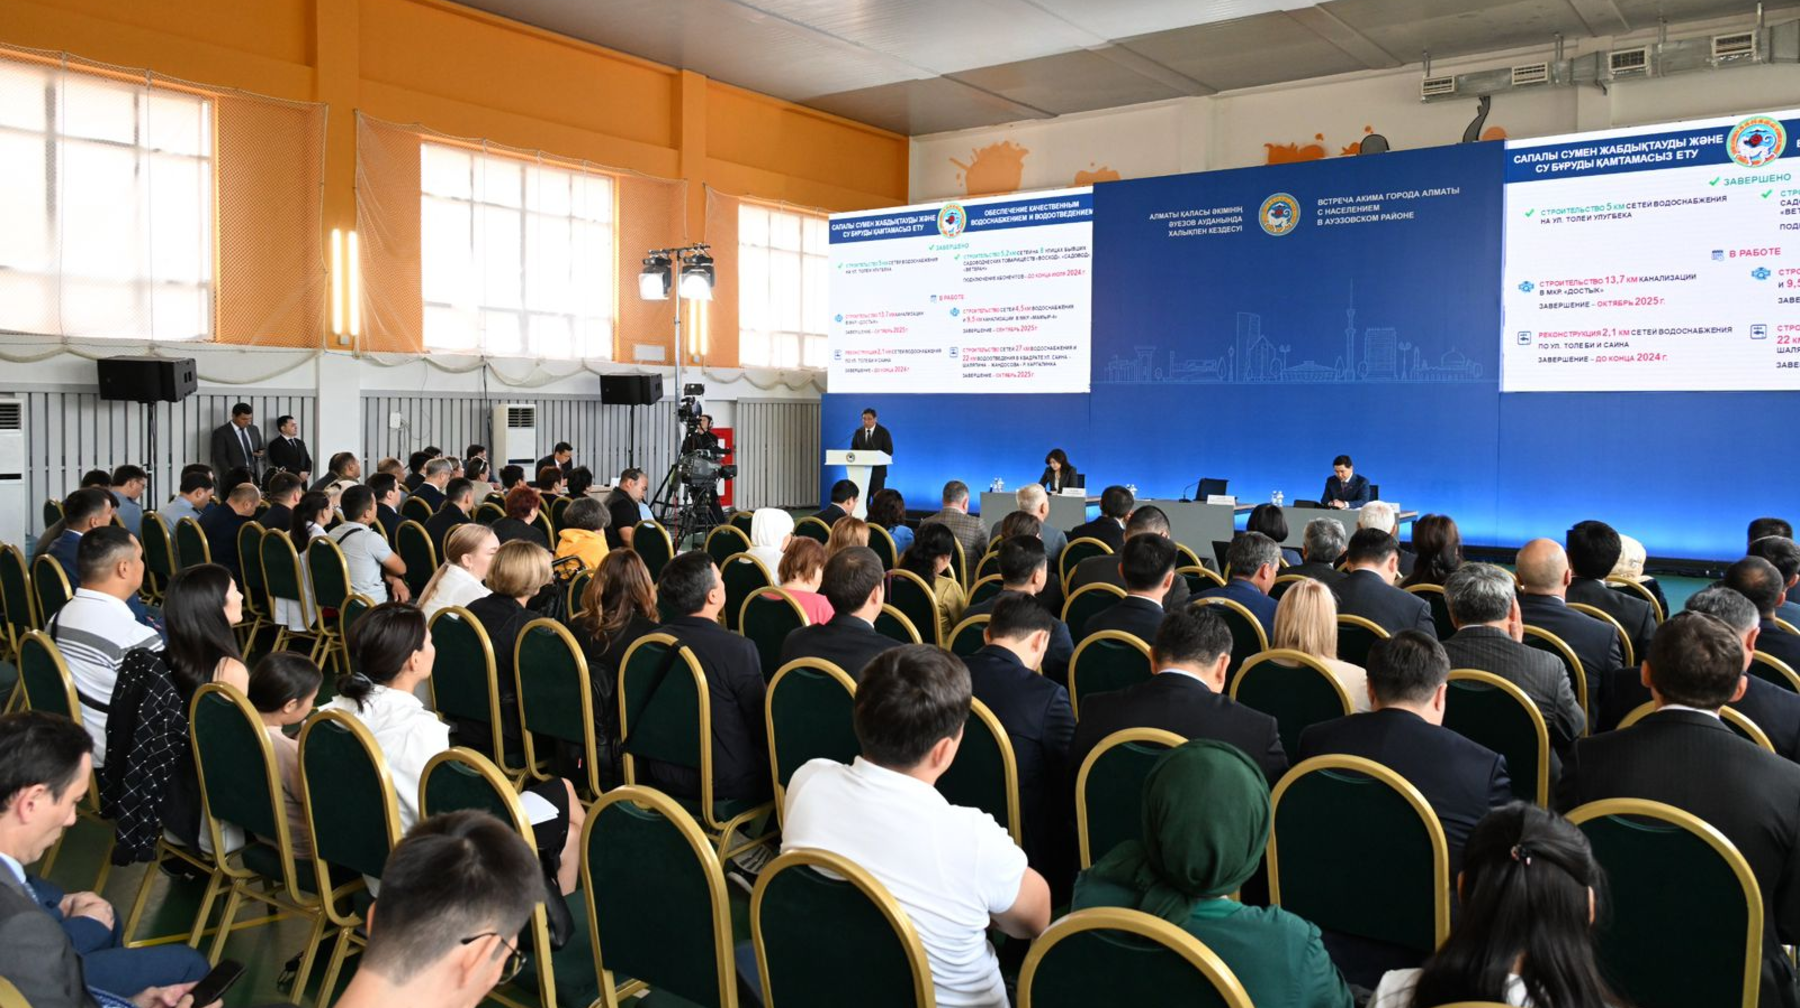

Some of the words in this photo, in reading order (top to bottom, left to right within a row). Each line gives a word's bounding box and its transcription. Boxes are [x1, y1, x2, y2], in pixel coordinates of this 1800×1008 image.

[1513, 152, 1558, 164] САПАЛЫ
[1561, 148, 1598, 159] СУМЕН
[1599, 138, 1687, 155] ЖАБДЫҚТАУДЫ
[1689, 134, 1724, 146] ЖӘНЕ
[1535, 164, 1549, 173] СУ
[1596, 151, 1673, 169] ҚАМТАМАСЫЗ
[1676, 149, 1699, 159] ЕТУ
[1724, 173, 1792, 186] ЗАВЕРШЕНО
[1317, 198, 1354, 206] ВСТРЕЧА
[1355, 194, 1384, 203] АКИМА
[1386, 191, 1420, 200] ГОРОДА
[1422, 187, 1459, 196] АЛМАТЫ
[984, 206, 1028, 216] ОБЕСПЕЧЕНИЕ
[1029, 201, 1079, 212] КАЧЕСТВЕННЫМ
[1325, 205, 1380, 215] НАСЕЛЕНИЕМ
[1541, 205, 1605, 216] СТРОИТЕЛЬСТВО
[1606, 203, 1612, 211] 5
[1653, 195, 1727, 207] ВОДОСНАБЖЕНИЯ
[970, 215, 1027, 226] ВОДОСНАБЖЕНИЕМ
[1149, 212, 1179, 220] АЛМАТЫ
[1180, 209, 1210, 218] ҚАЛАСЫ
[1324, 215, 1379, 225] АУЭЗОВСКОМ
[1381, 211, 1415, 221] РАЙОНЕ
[1169, 220, 1196, 228] ӘУЕЗОВ
[1197, 216, 1242, 226] АУДАНЫНДА
[1168, 229, 1207, 237] ХАЛЫҚПЕН
[1208, 226, 1242, 234] КЕЗДЕСУІ
[1729, 250, 1736, 258] В
[1739, 248, 1781, 257] РАБОТЕ
[1539, 278, 1604, 288] СТРОИТЕЛЬСТВО
[1605, 275, 1626, 285] 13,7
[1639, 273, 1697, 283] КАНАЛИЗАЦИИ
[1539, 301, 1590, 310] ЗАВЕРШЕНИЕ
[1597, 299, 1634, 308] ОКТЯБРЬ
[1635, 296, 1659, 306] 2025
[1538, 330, 1601, 338] РЕКОНСТРУКЦИЯ
[1602, 328, 1616, 337] 2,1
[1659, 327, 1733, 336] ВОДОСНАБЖЕНИЯ
[1777, 335, 1790, 344] 22
[1637, 353, 1661, 362] 2024
